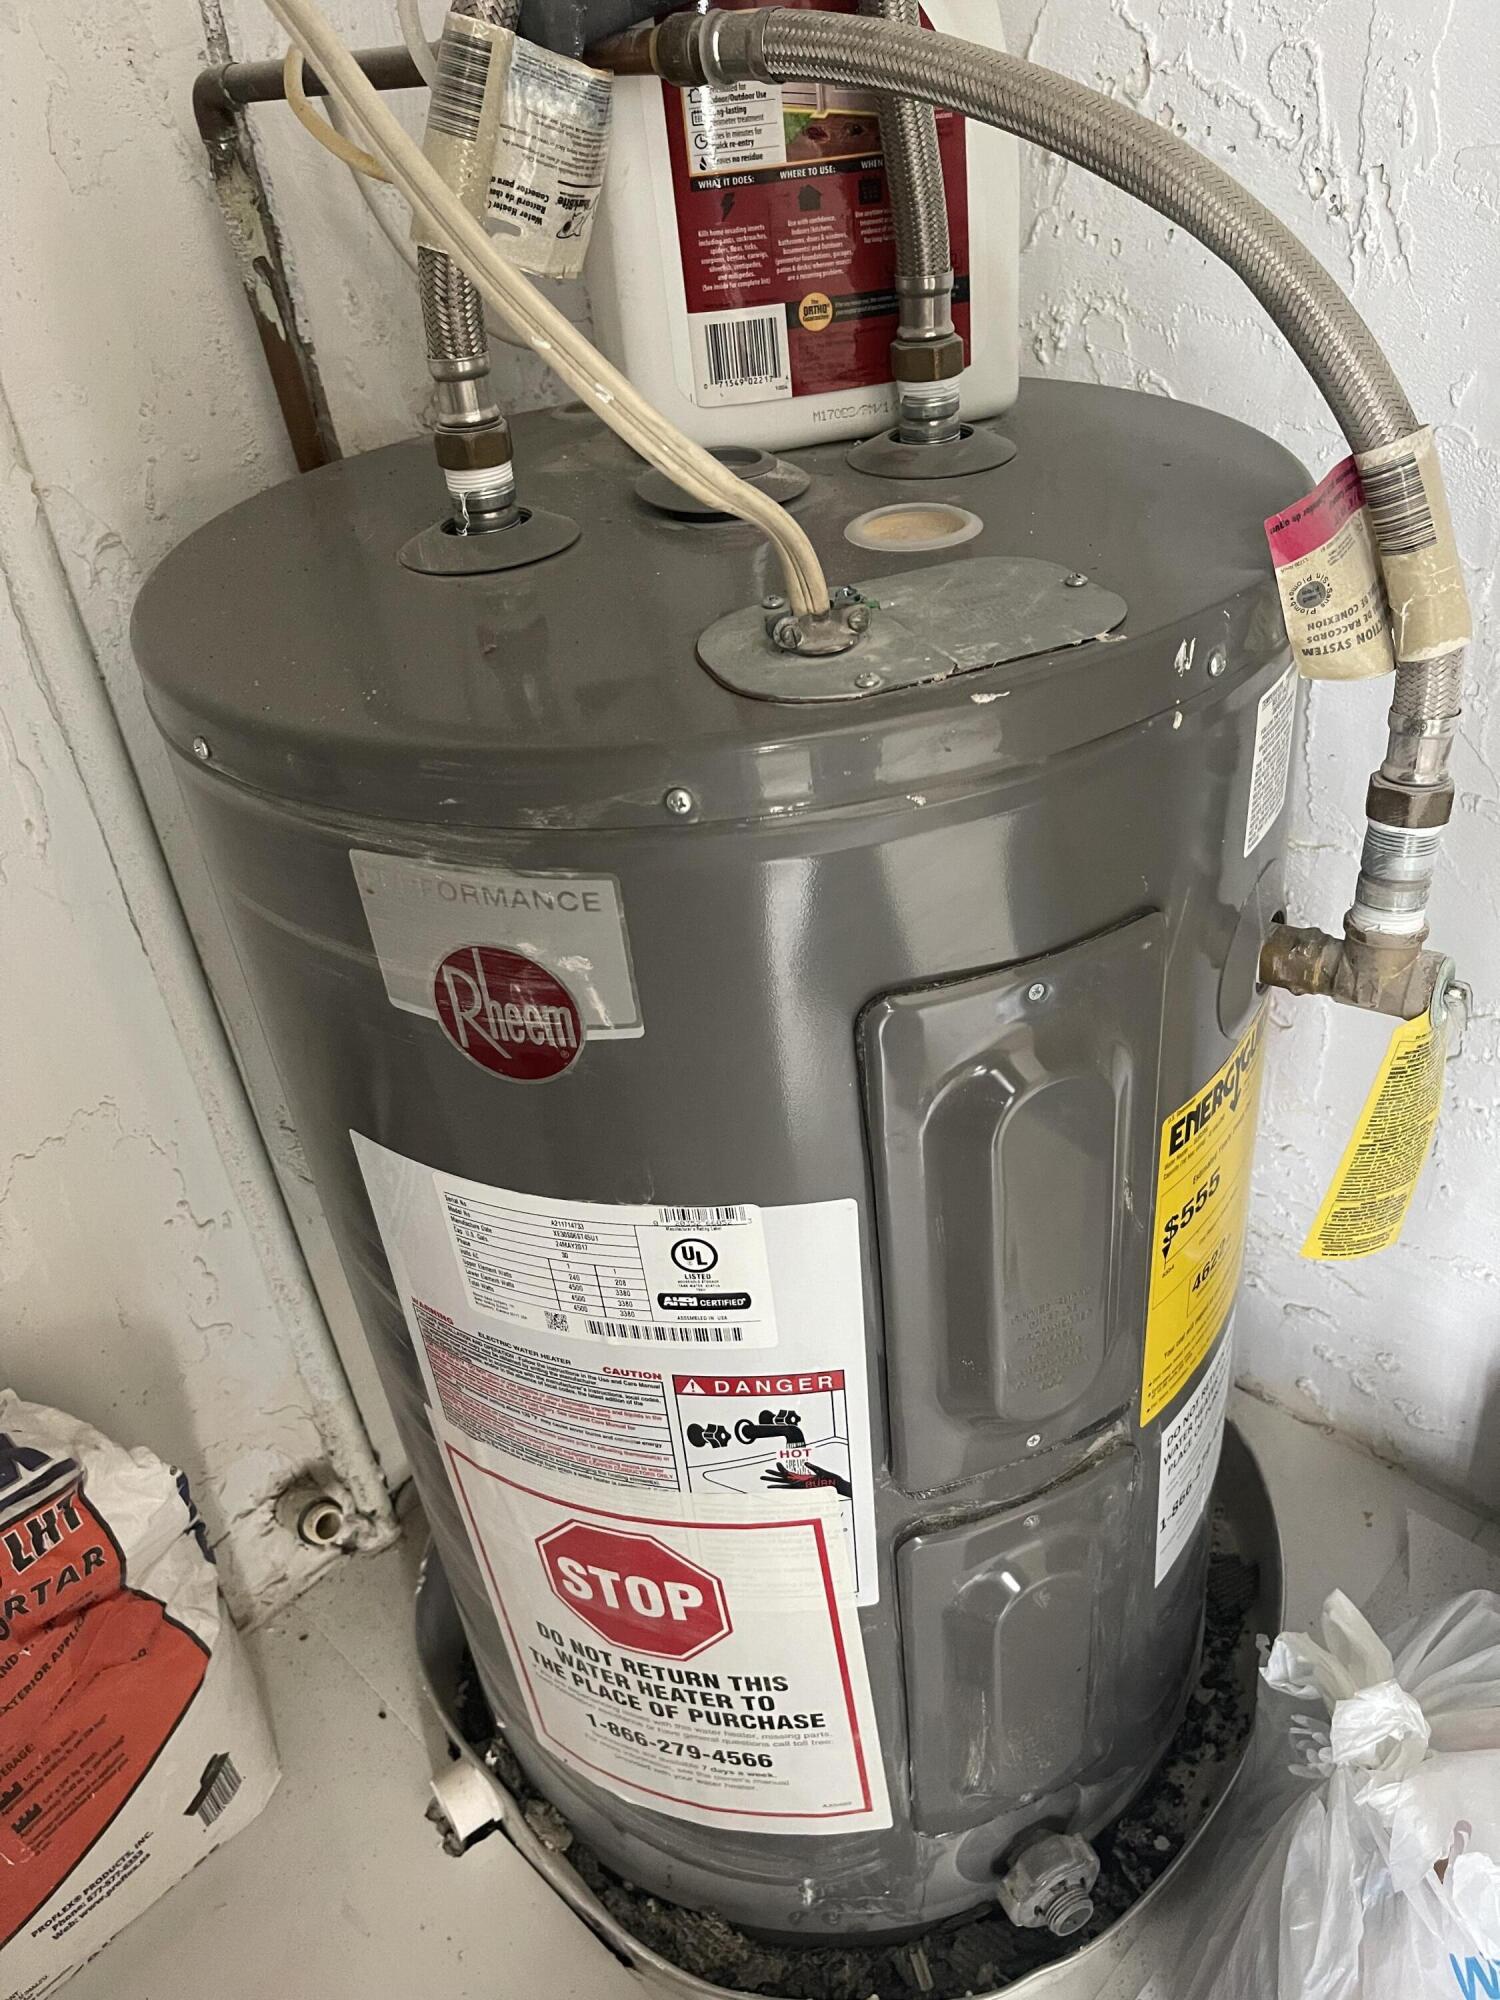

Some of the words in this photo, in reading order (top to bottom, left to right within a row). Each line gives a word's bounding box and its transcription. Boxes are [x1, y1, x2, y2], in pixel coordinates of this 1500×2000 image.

[756, 91, 767, 99] Use
[729, 139, 754, 148] re-entry
[741, 152, 763, 161] residue
[861, 159, 884, 169] WHEN
[780, 168, 807, 179] WHERE
[808, 167, 818, 176] TO
[819, 166, 836, 175] USE:
[698, 178, 721, 189] WHAT
[723, 177, 731, 186] IT
[732, 176, 755, 185] DOES:
[803, 304, 828, 316] ORTHO
[718, 378, 744, 388] 71549
[748, 375, 773, 385] 02217
[1307, 619, 1362, 644] RACCORDS
[1301, 638, 1352, 657] SYSTEM
[442, 947, 578, 1059] Rheem
[1162, 1166, 1222, 1246] $555
[681, 1246, 708, 1266] UL
[568, 1273, 580, 1281] 240
[614, 1279, 627, 1287] 208
[568, 1283, 584, 1292] 4500
[615, 1289, 631, 1297] 3380
[571, 1294, 586, 1303] 4500
[617, 1300, 633, 1308] 3380
[700, 1298, 744, 1307] CERTIFIED
[620, 1310, 635, 1318] 3380
[477, 1331, 512, 1349] ELECTRIC
[513, 1346, 539, 1357] WATER
[540, 1352, 572, 1365] HEATER
[602, 1366, 662, 1380] CAUTION
[714, 1376, 833, 1394] DANGER
[1166, 1424, 1182, 1447] DO
[1182, 1401, 1200, 1428] NOT
[779, 1448, 812, 1459] HOT
[1163, 1427, 1194, 1465] WATER
[1167, 1441, 1194, 1476] PLACE
[805, 1478, 837, 1488] BURN
[557, 1556, 704, 1621] STOP
[536, 1620, 564, 1647] DO
[569, 1638, 612, 1667] NOT
[620, 1656, 720, 1690] RETURN
[728, 1675, 789, 1692] THIS
[529, 1646, 566, 1680] THE
[572, 1671, 643, 1712] PLACE
[649, 1701, 679, 1719] OF
[689, 1708, 826, 1731] PURCHASE
[554, 1647, 631, 1690] WATER
[638, 1678, 735, 1710] HEATER
[740, 1695, 776, 1712] TO
[585, 1711, 774, 1769] 1-866-279-4566
[134, 1831, 154, 1849] INC.
[52, 1902, 87, 1931] Phone:
[52, 1918, 79, 1940] Web:
